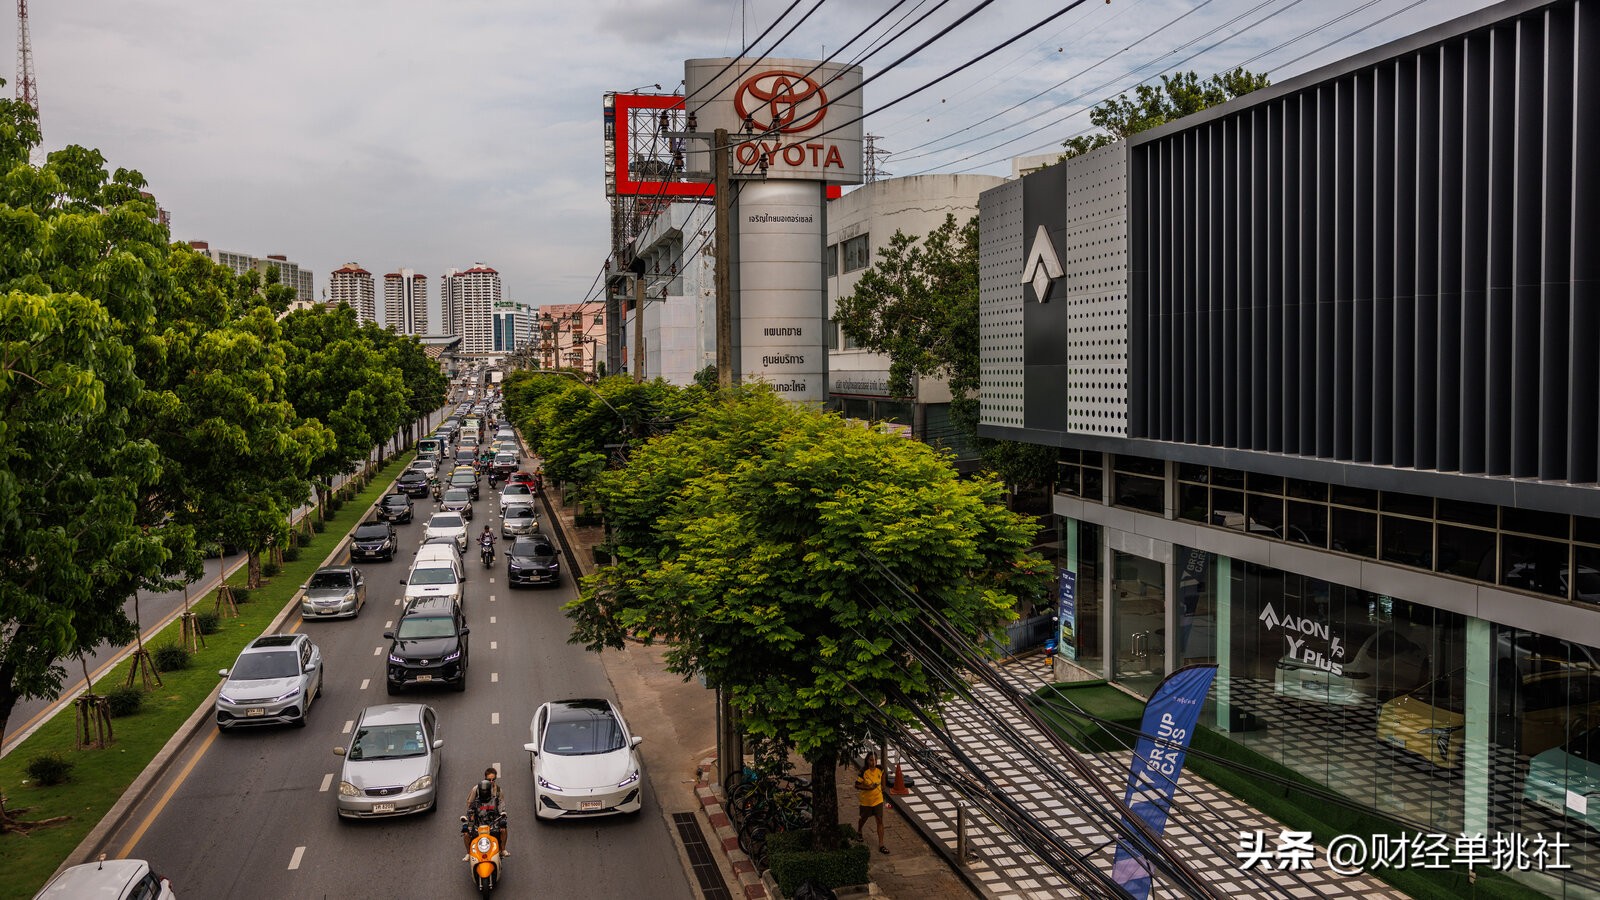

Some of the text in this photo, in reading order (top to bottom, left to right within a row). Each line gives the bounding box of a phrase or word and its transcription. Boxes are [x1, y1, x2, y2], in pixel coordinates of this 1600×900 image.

[735, 142, 844, 169] OYOTA
[763, 327, 802, 336] แผนกขาย
[762, 352, 805, 367] ศูนย์บริการ
[1281, 614, 1329, 640] AION
[1285, 634, 1305, 659] Y
